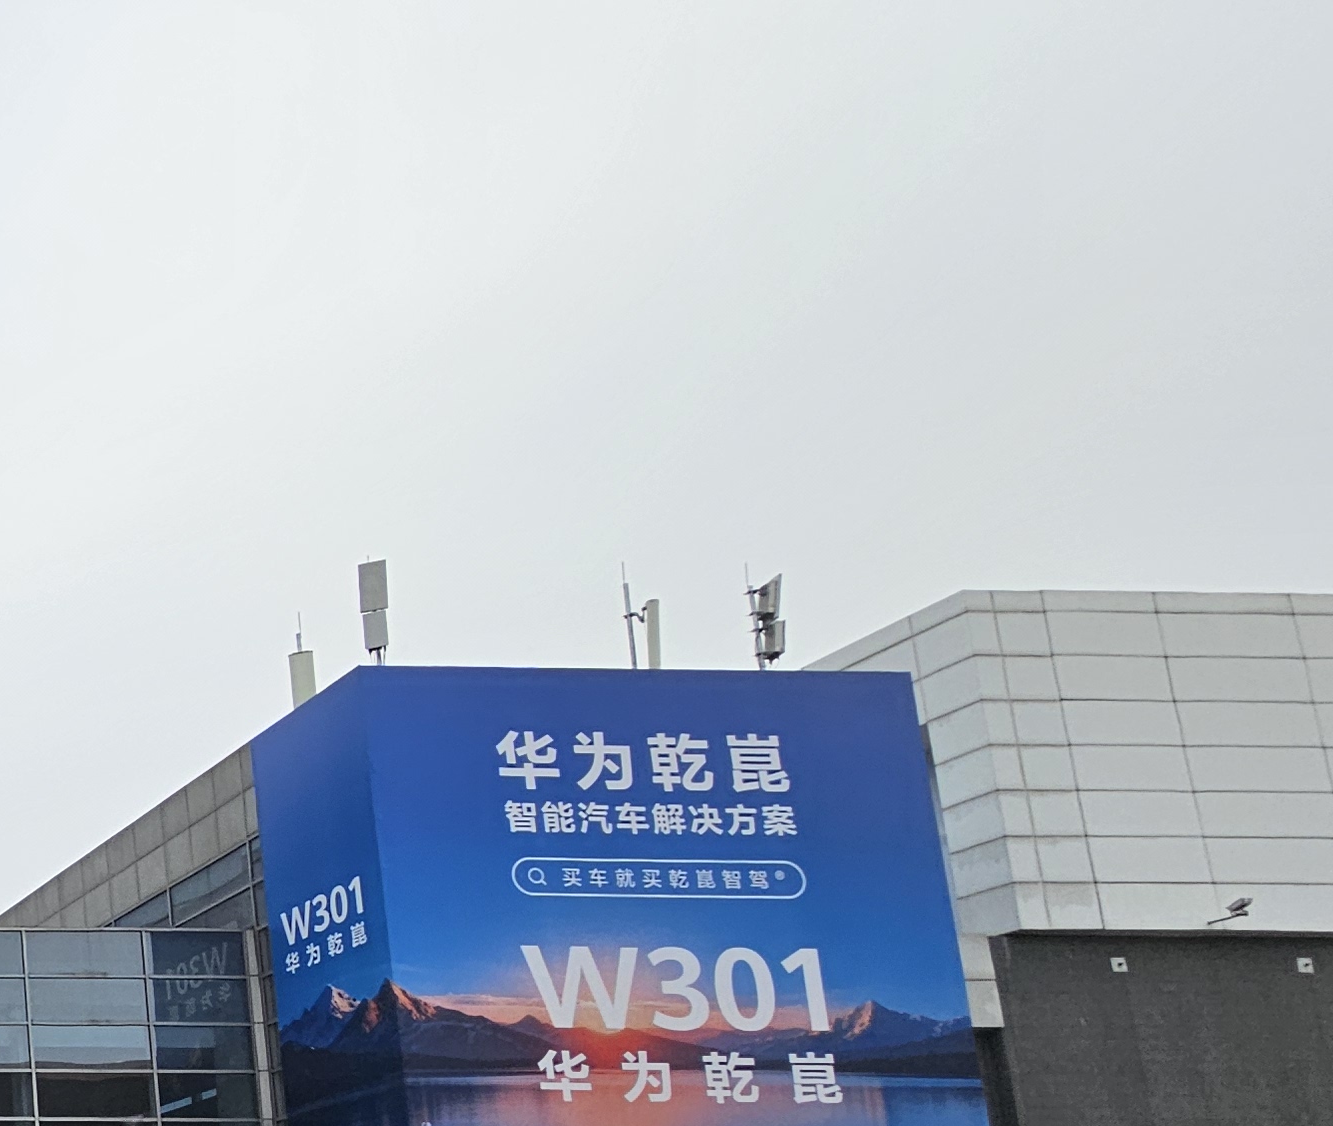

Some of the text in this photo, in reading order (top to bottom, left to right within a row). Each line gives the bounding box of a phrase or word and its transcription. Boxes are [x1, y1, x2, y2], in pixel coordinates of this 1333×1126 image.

[495, 729, 792, 794] 华为乾崑
[503, 800, 799, 838] 智能汽车解决方案
[280, 875, 364, 946] W301
[285, 920, 368, 975] 华为乾崑
[520, 944, 832, 1034] W301
[537, 1049, 845, 1106] 华为乾崑
